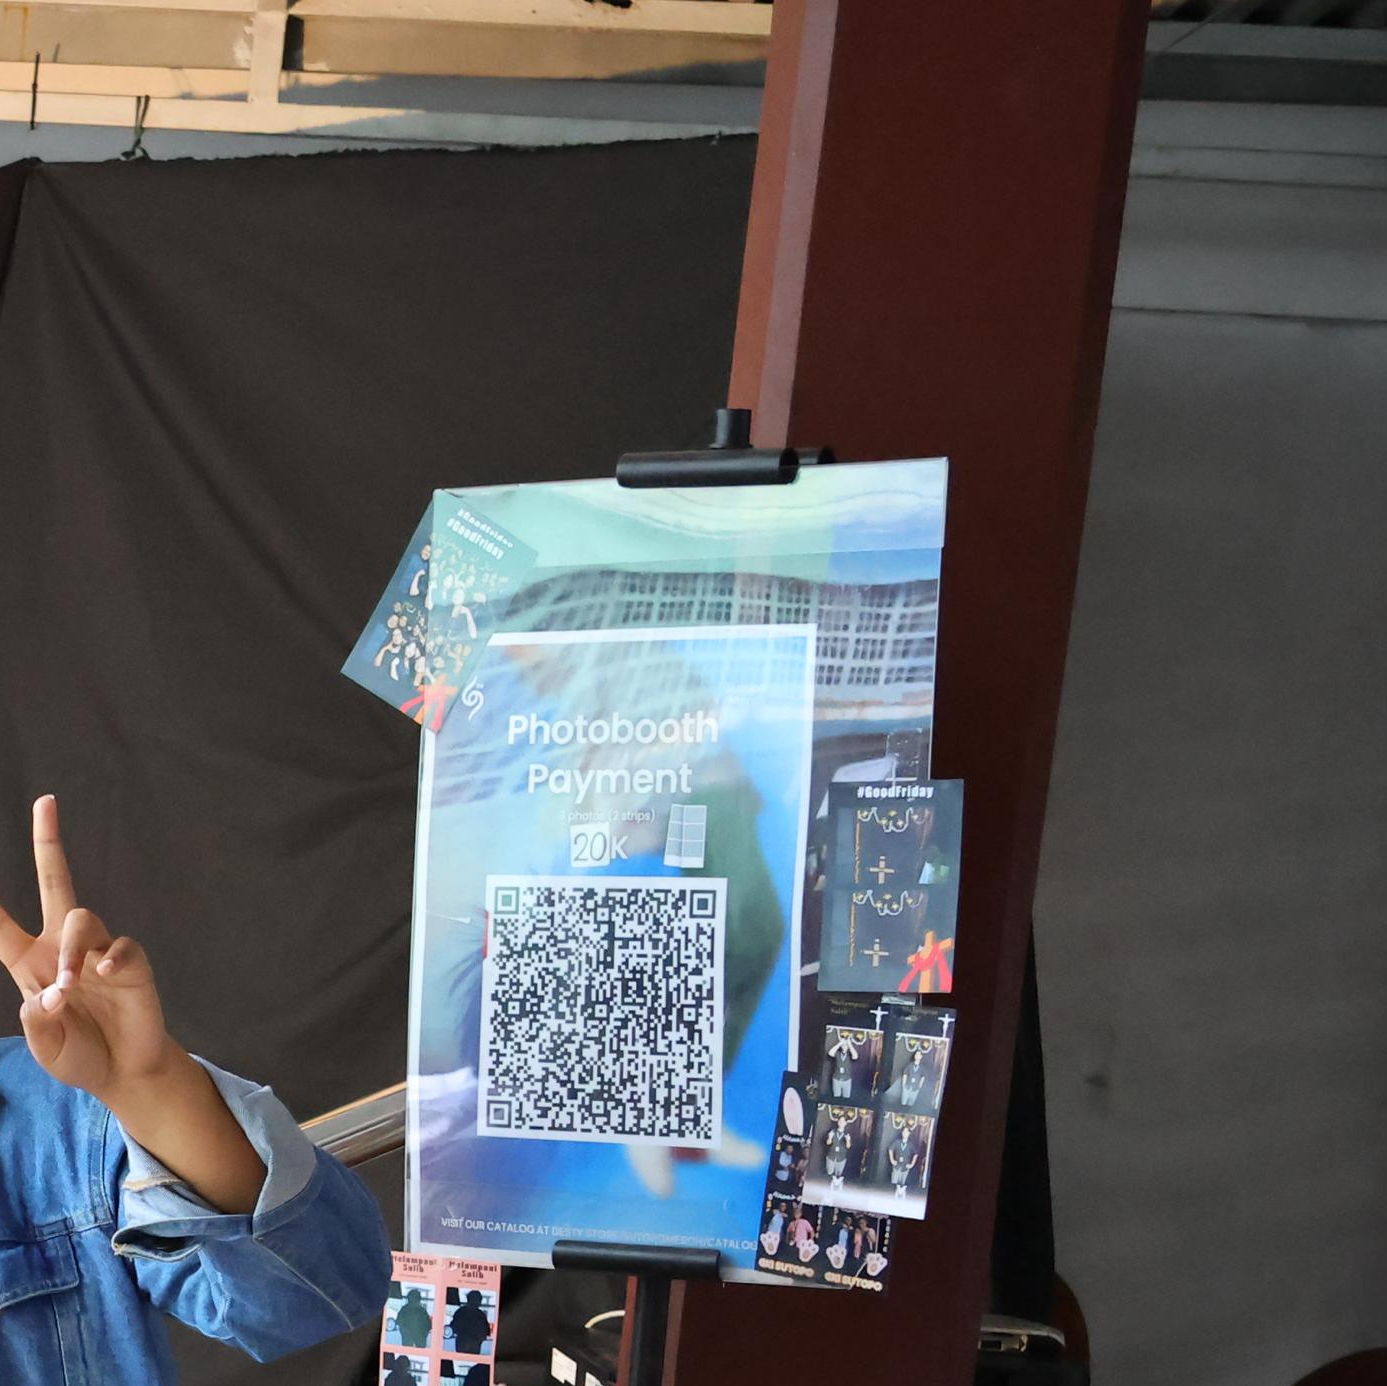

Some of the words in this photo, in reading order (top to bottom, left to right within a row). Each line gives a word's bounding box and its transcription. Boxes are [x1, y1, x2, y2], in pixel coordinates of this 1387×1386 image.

[446, 517, 505, 560] #GoodFriday
[508, 711, 719, 745] Photobooth
[528, 762, 693, 804] Payment
[857, 785, 934, 799] #GoodFriday
[441, 1216, 464, 1228] VISIT
[465, 1219, 485, 1231] OUR
[487, 1221, 535, 1235] CATALOG
[536, 1225, 549, 1236] AT
